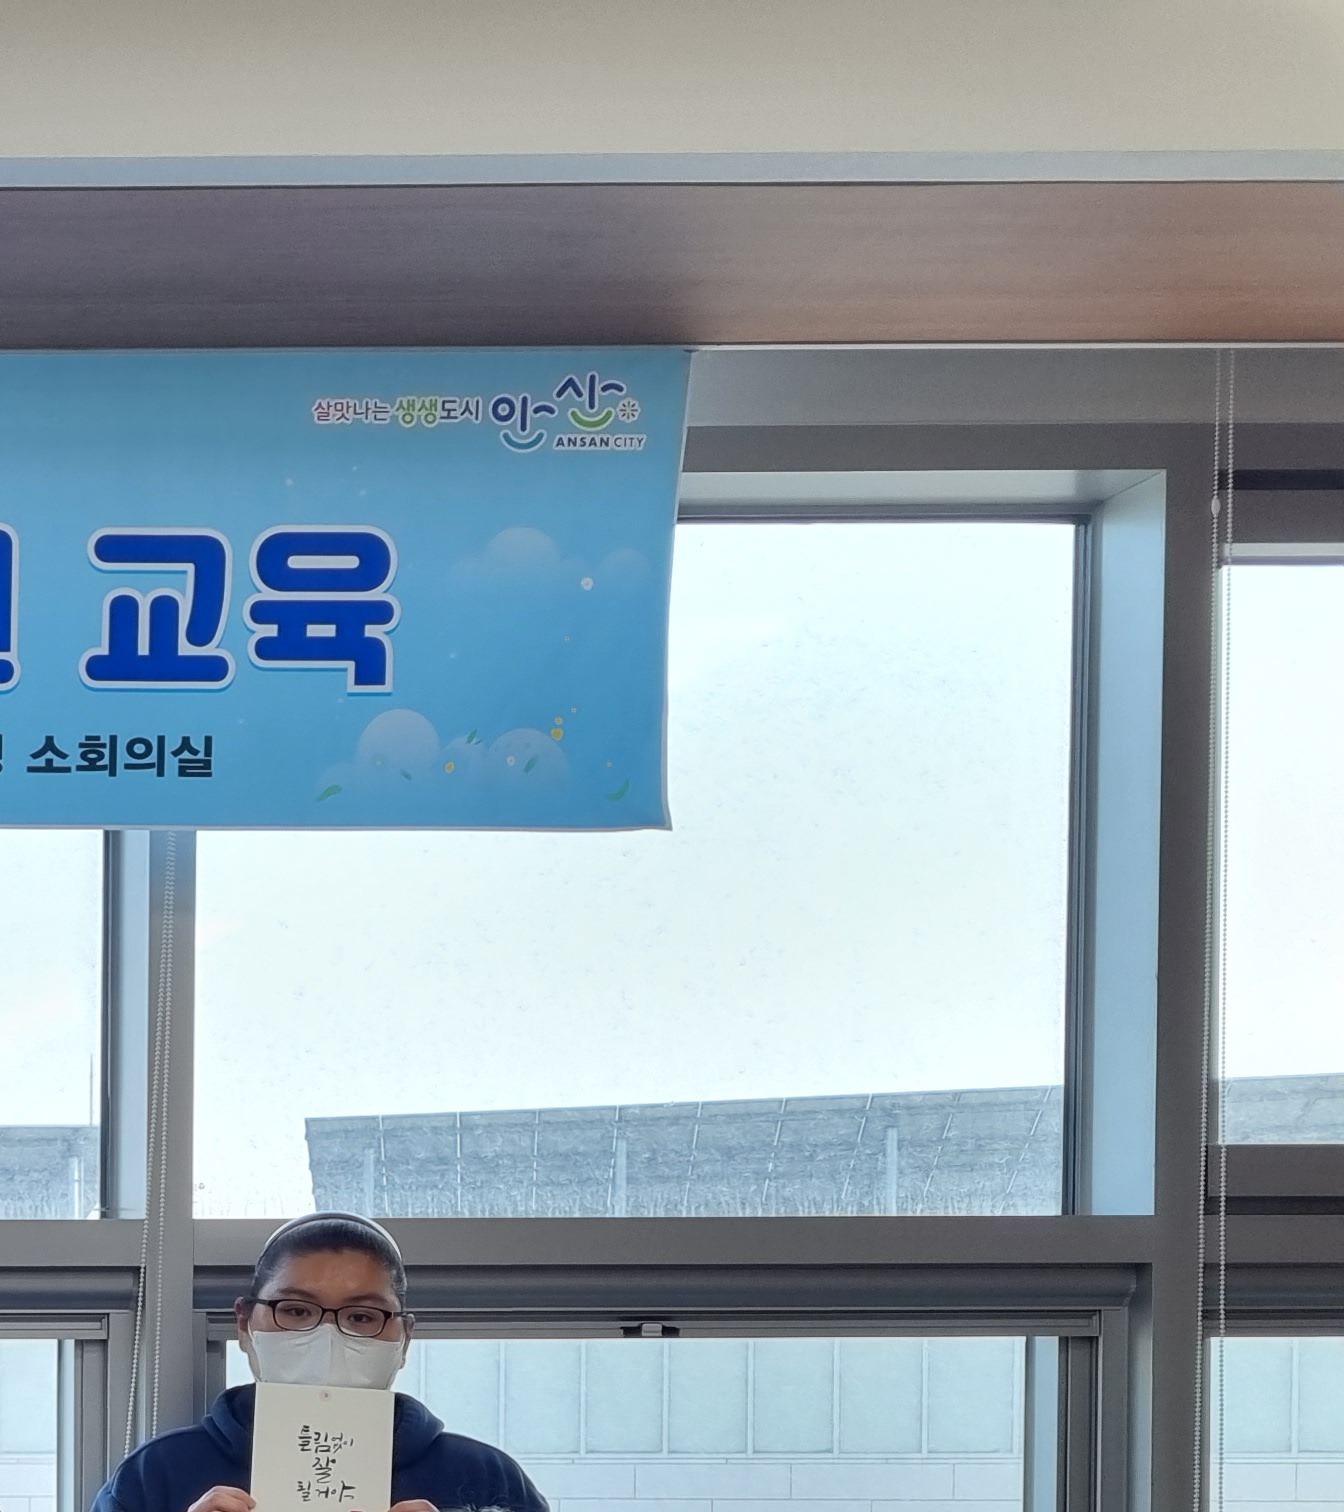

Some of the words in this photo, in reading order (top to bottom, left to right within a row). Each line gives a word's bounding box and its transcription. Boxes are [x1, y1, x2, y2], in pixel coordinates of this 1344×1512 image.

[314, 400, 390, 422] 살맛나는
[395, 397, 480, 426] 생생도시
[555, 437, 610, 448] ANSAN
[613, 437, 645, 448] CITY
[84, 532, 395, 688] 교육
[25, 734, 214, 778] 소회의실
[311, 1455, 337, 1484] 잘
